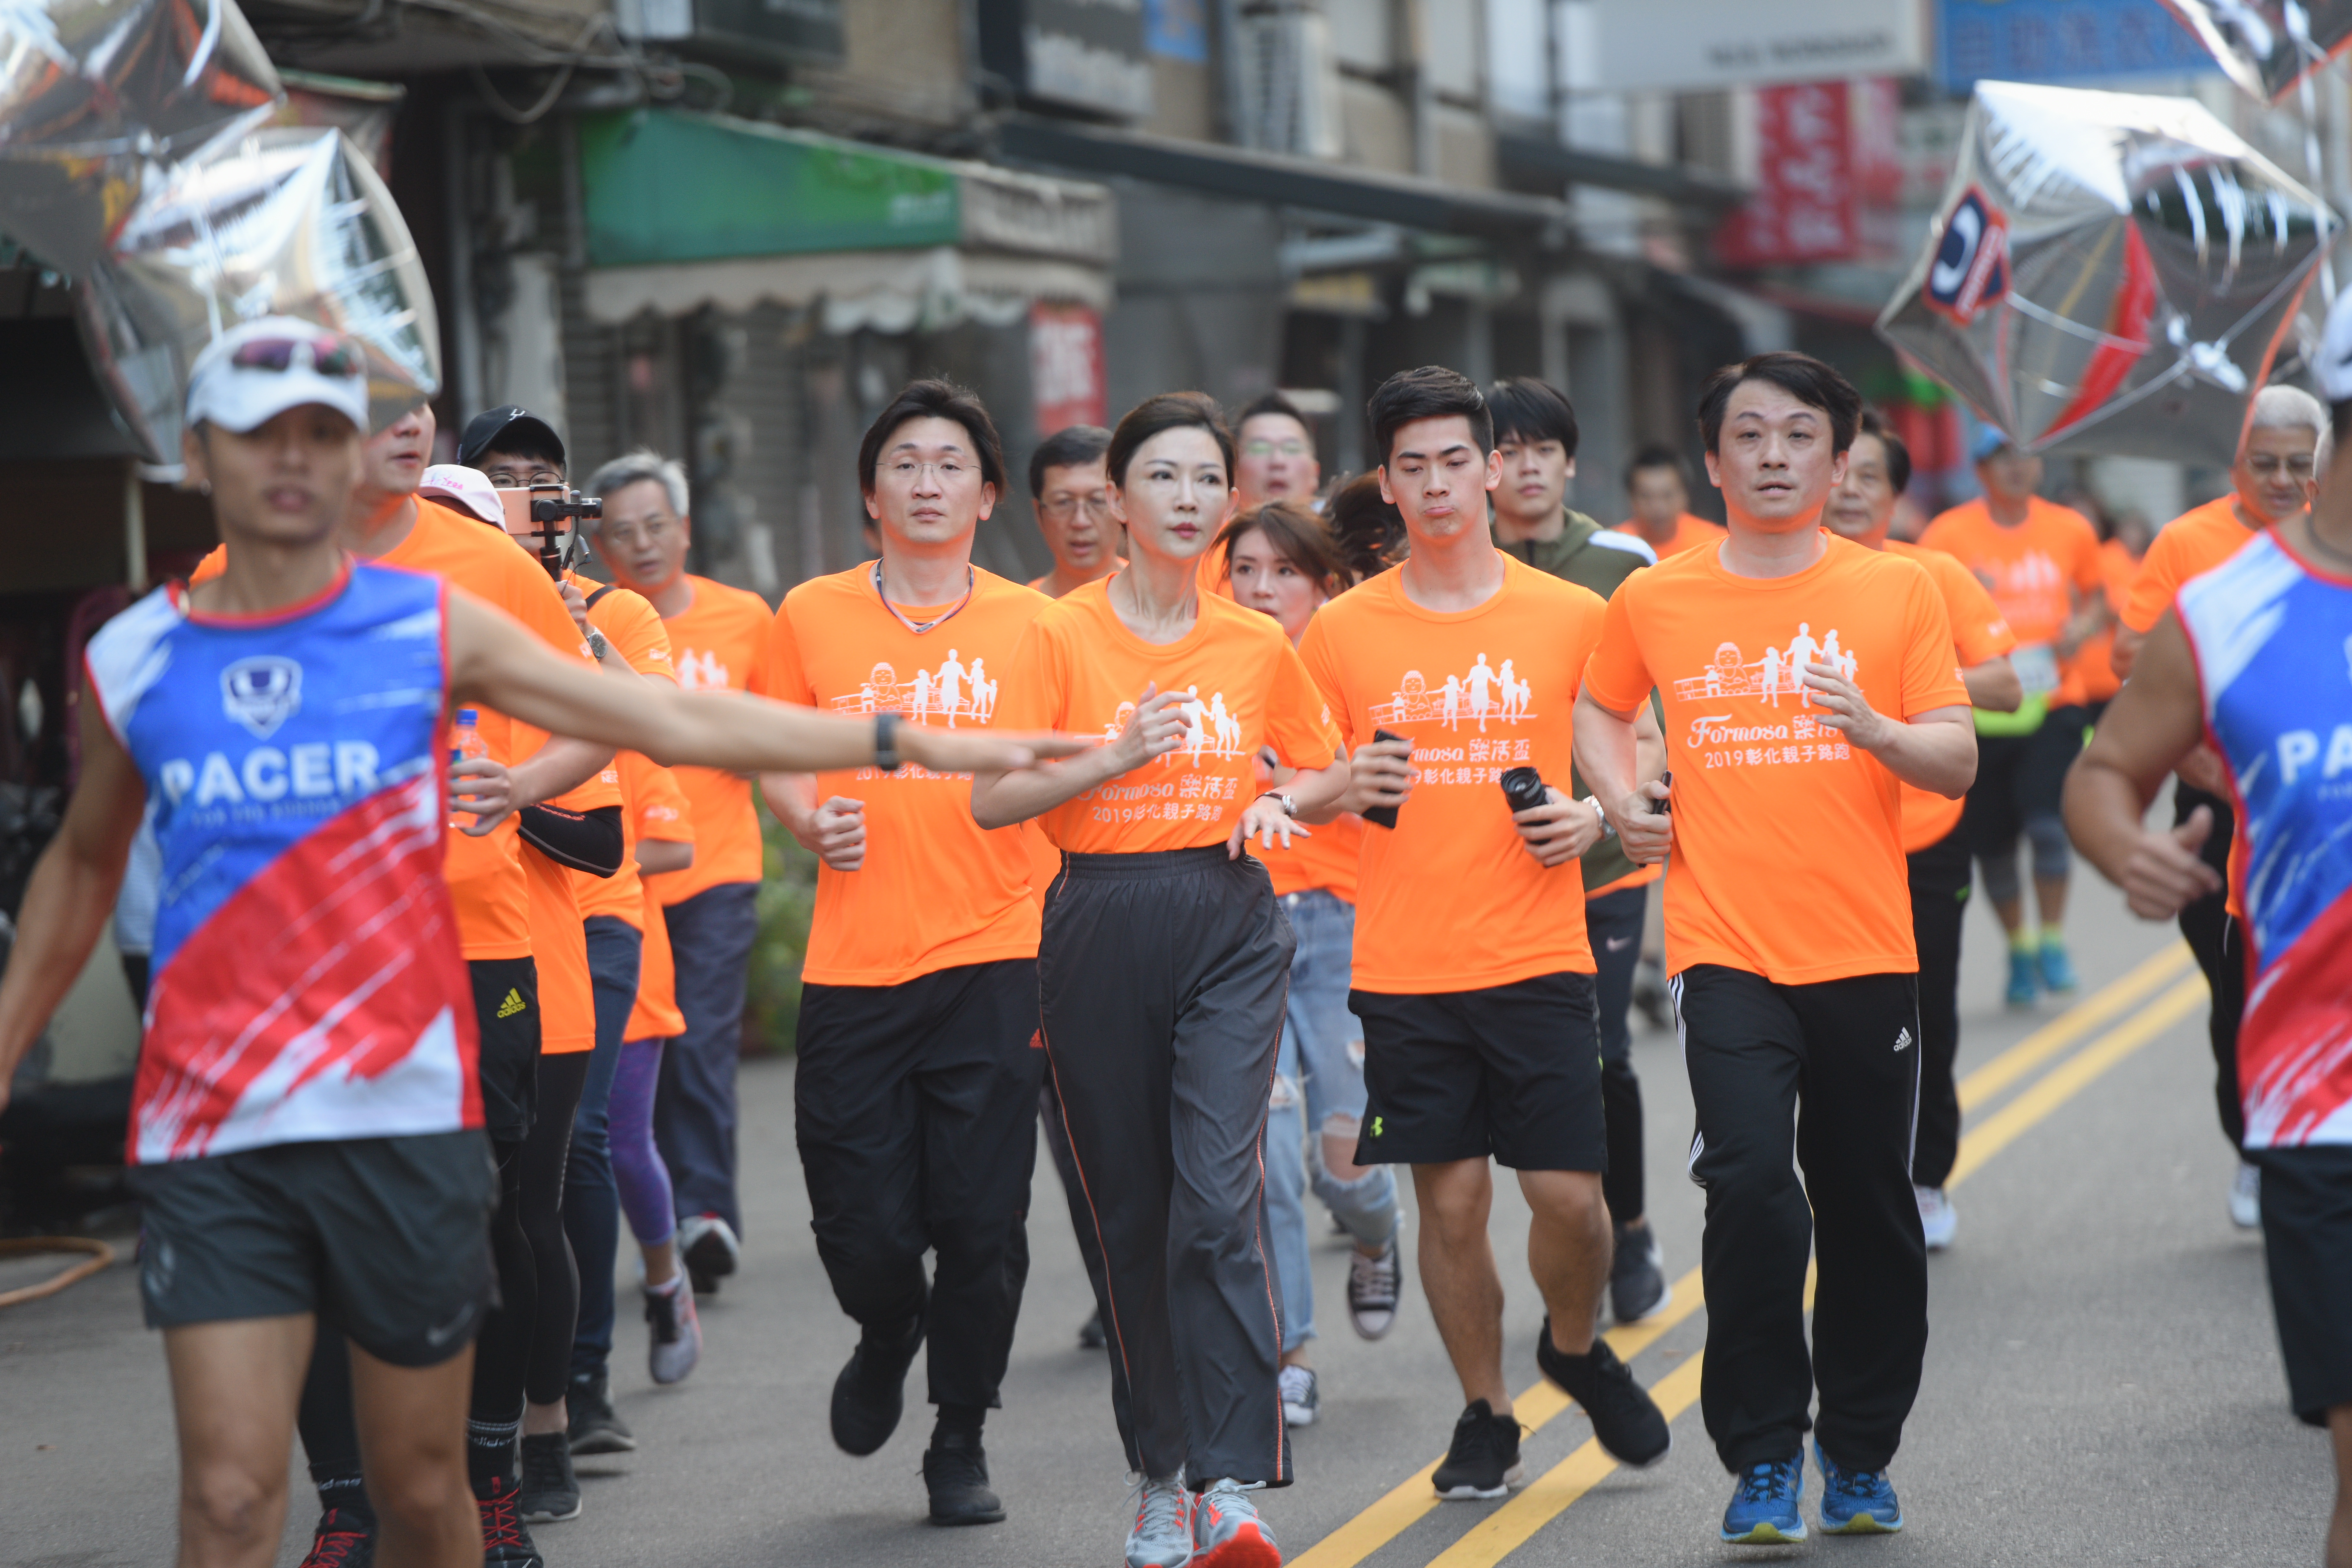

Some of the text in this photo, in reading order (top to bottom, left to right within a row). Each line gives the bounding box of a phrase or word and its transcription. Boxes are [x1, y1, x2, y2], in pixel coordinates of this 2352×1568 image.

[1687, 713, 1788, 748] Formosa
[1469, 738, 1531, 762] 樂活盃
[1705, 743, 1850, 768] 2019彰化親子路跑
[160, 740, 380, 808] PACER
[1179, 773, 1238, 800] 樂活盃
[496, 1001, 526, 1019] adidas
[1893, 1036, 1912, 1052] adidas
